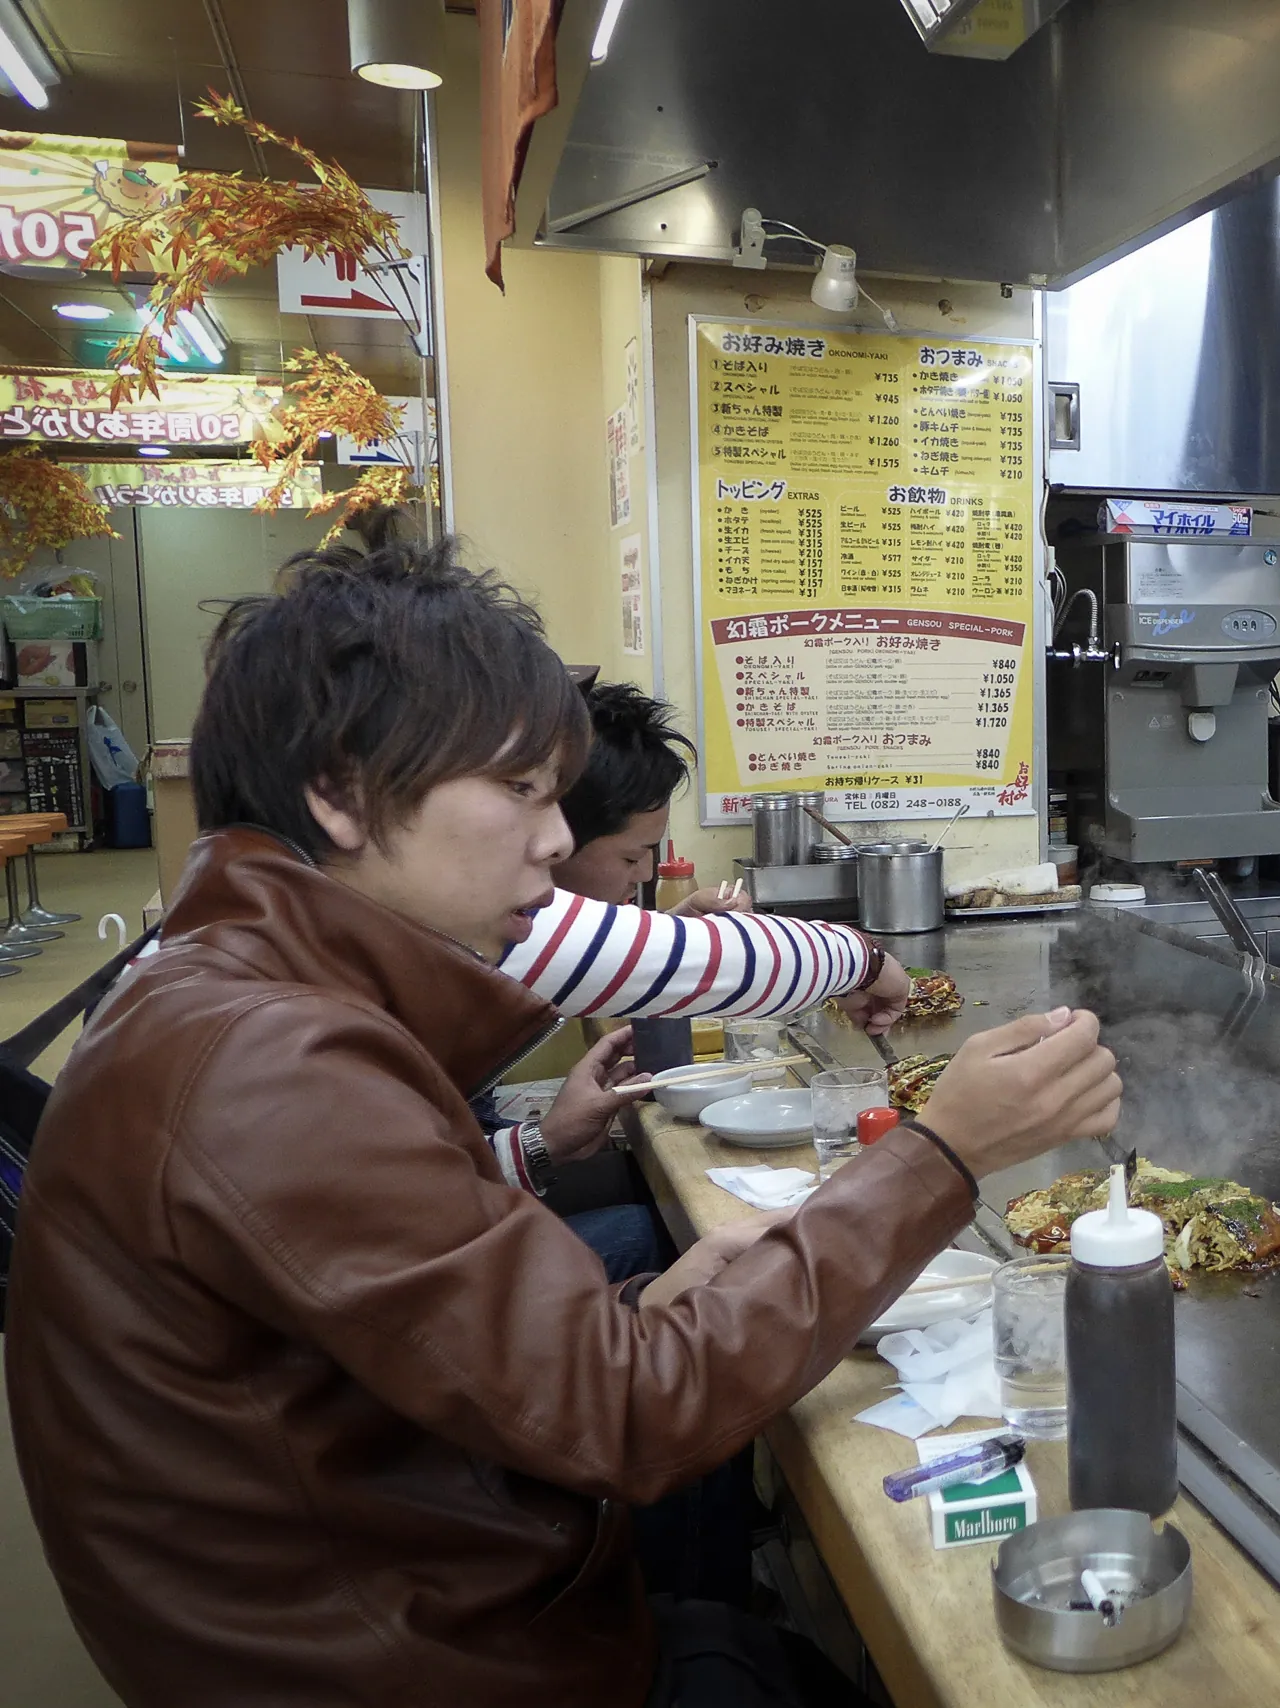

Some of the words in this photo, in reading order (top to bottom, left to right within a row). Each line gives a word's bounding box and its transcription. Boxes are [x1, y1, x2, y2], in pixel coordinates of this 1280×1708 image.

[722, 333, 825, 357] お好み焼き
[829, 350, 888, 361] OKONOMI-YAKI
[921, 347, 983, 367] おつまみ
[987, 359, 1018, 368] SNACS
[722, 360, 767, 372] そば入り
[875, 373, 898, 383] ¥735
[920, 371, 958, 382] かき焼き
[723, 382, 780, 395] スペシャル
[875, 395, 899, 403] ¥945
[721, 404, 783, 417] 新ちゃん特製
[1001, 412, 1022, 422] ¥735
[724, 425, 769, 437] かきそば
[920, 421, 959, 433] 豚キムチ
[1000, 427, 1022, 436] ¥735
[921, 437, 959, 448] イカ焼き
[1000, 441, 1022, 451] ¥735
[723, 447, 786, 460] 特製スペシャル
[920, 451, 959, 462] ねぎ焼き
[1000, 455, 1022, 465] ¥735
[920, 466, 949, 476] キムチ
[1000, 470, 1022, 479] ¥210
[718, 479, 785, 500] トッピング
[787, 492, 819, 500] EXTRAS
[889, 485, 946, 504] お飲物
[951, 498, 983, 506] DRINKS
[798, 508, 822, 518] ¥525
[882, 507, 901, 515] ¥525
[724, 516, 749, 524] ホタテ
[798, 519, 822, 528] ¥525
[1150, 510, 1215, 526] マイホイル
[1005, 523, 1022, 531] ¥420
[798, 529, 822, 538] ¥315
[724, 537, 749, 545] 生エビ
[799, 539, 822, 548] ¥315
[799, 549, 822, 558] ¥210
[1004, 555, 1022, 563] ¥420
[725, 557, 750, 565] イカ天
[799, 559, 822, 568] ¥157
[799, 569, 822, 577] ¥157
[946, 572, 965, 580] ¥210
[726, 577, 758, 585] ねぎかけ
[799, 579, 822, 588] ¥157
[799, 589, 817, 598] ¥31
[882, 585, 901, 593] ¥315
[726, 612, 899, 640] 幻霜ポークメニュー
[907, 619, 942, 628] GENSOU
[949, 622, 1013, 637] SPECIAL-PORK
[804, 638, 869, 648] 幻霜ポーク入り
[876, 635, 941, 651] お好み焼き
[745, 656, 794, 664] そば入り
[992, 659, 1016, 669] ¥840
[746, 672, 805, 680] スペシャル
[745, 687, 809, 696] 新ちゃん特製
[746, 703, 796, 711] かきそば
[746, 718, 815, 727] 特製スペシャル
[813, 735, 877, 745] 幻霜ポーク入り
[882, 733, 931, 746] おつまみ
[977, 749, 1000, 758] ¥840
[757, 762, 802, 771] ねぎ焼き
[976, 760, 999, 769] ¥840
[825, 776, 899, 786] お持ち帰りケース
[905, 775, 923, 785] ¥31
[845, 801, 867, 810] TEL
[871, 800, 899, 810] (082)
[906, 798, 961, 808] 248-0188
[954, 1510, 1017, 1538] Marlboro
